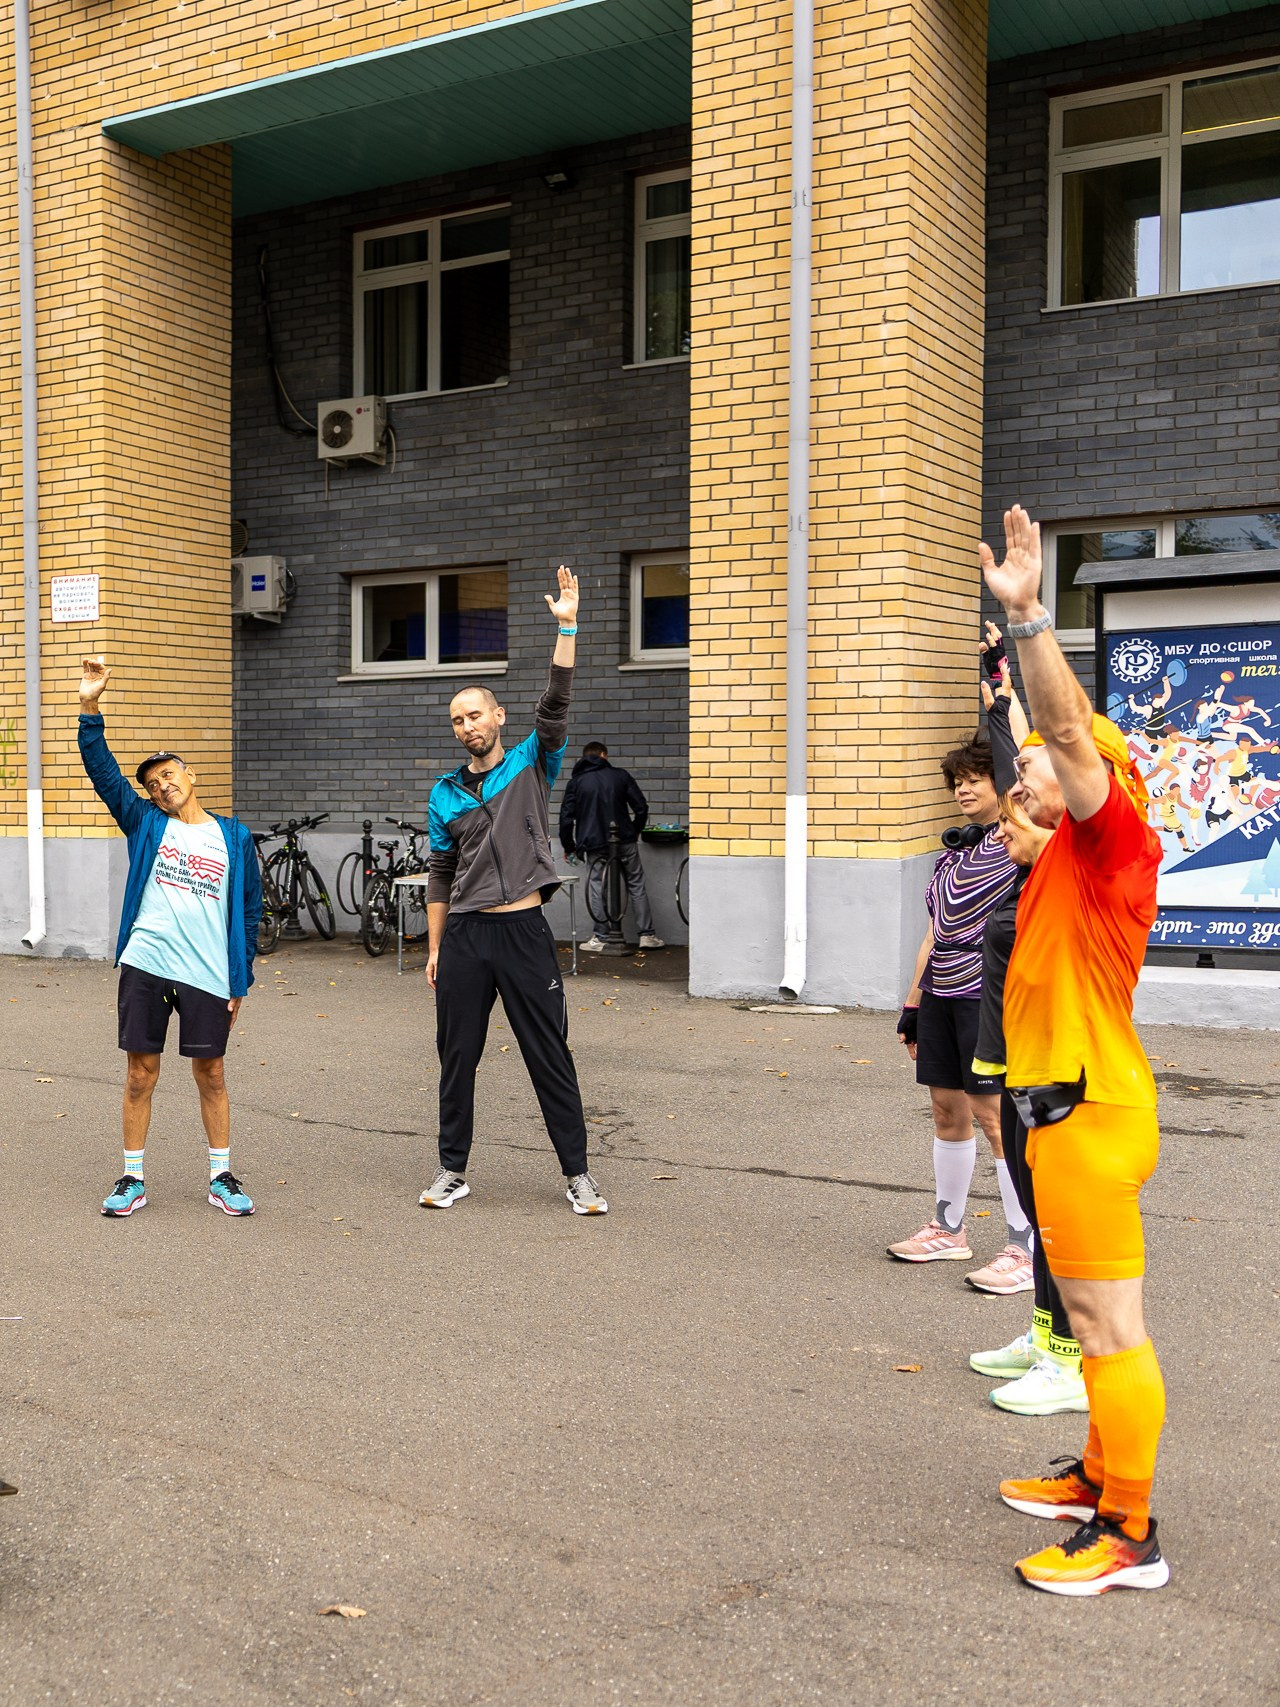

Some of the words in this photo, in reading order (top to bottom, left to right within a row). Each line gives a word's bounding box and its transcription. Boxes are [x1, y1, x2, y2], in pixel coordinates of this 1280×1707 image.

[1164, 643, 1195, 656] МБУ
[1198, 643, 1221, 656] ДО
[1189, 656, 1241, 665] спортивная
[1248, 654, 1278, 662] школа
[1239, 803, 1280, 840] КАТ
[1206, 921, 1247, 935] это
